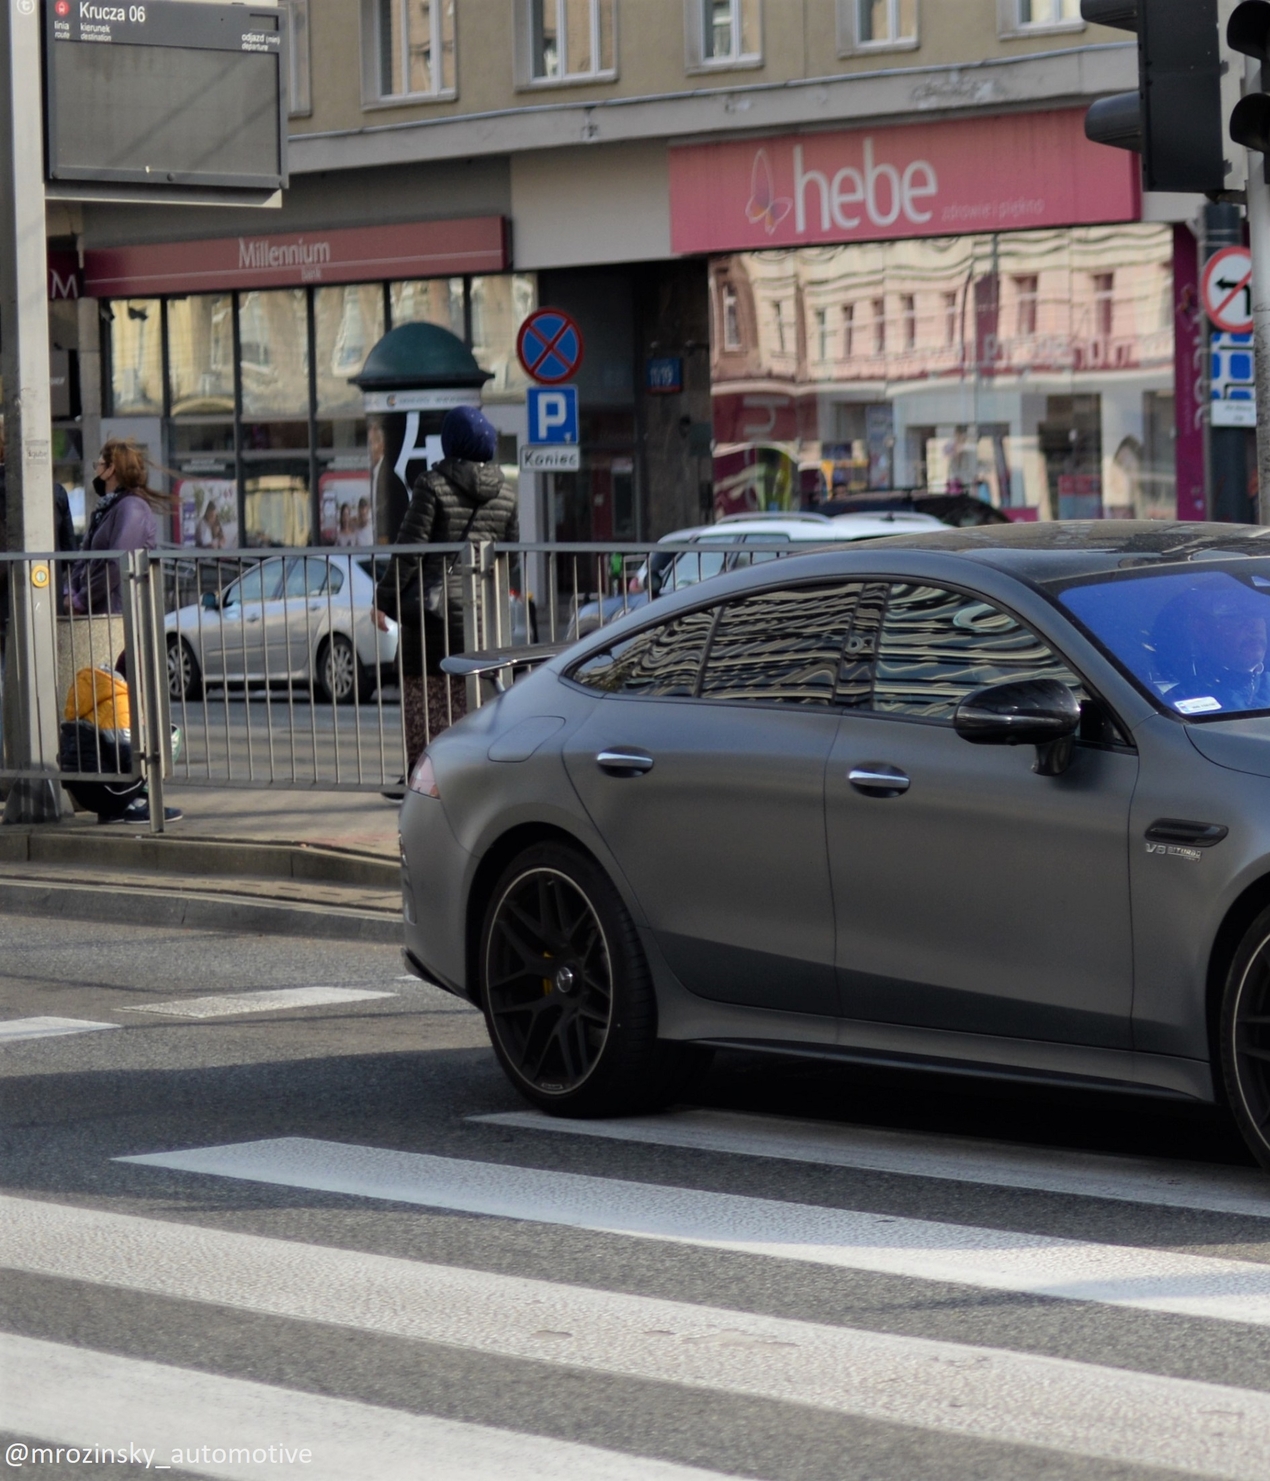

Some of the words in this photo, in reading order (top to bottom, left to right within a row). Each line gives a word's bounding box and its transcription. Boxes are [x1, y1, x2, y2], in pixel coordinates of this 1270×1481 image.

[80, 2, 125, 20] Krucza
[129, 6, 146, 22] 06
[54, 21, 69, 30] linia
[80, 23, 111, 33] kierunek
[80, 32, 112, 41] destination
[793, 137, 938, 234] hebe
[238, 237, 330, 269] Millennium
[524, 452, 578, 467] Koniec
[1146, 843, 1166, 855] V8
